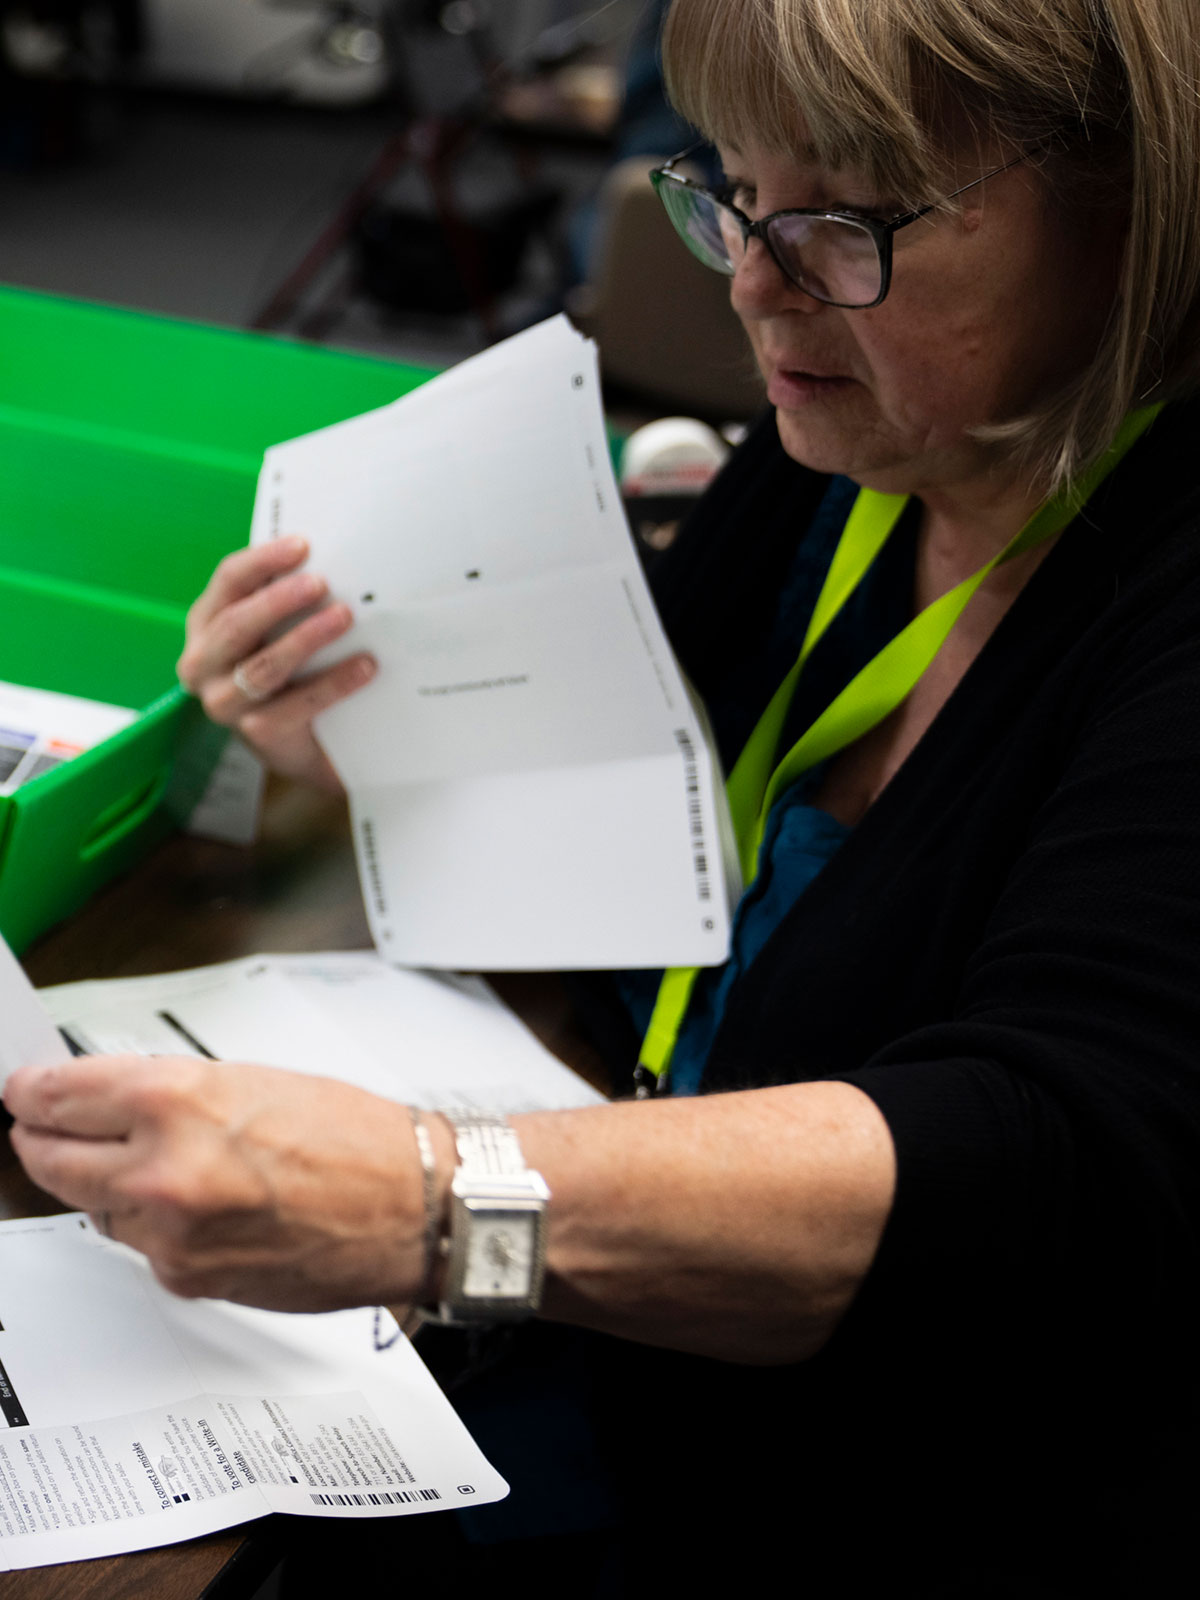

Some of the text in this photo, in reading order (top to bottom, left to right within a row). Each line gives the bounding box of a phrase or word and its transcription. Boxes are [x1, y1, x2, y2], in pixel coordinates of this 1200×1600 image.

[0, 1387, 12, 1398] End
[196, 1418, 216, 1447] Write-in
[132, 1441, 151, 1469] mistake
[214, 1452, 226, 1463] for
[222, 1463, 235, 1480] vote
[232, 1450, 256, 1484] candidate
[148, 1474, 166, 1499] correct
[231, 1480, 241, 1491] To
[161, 1500, 171, 1510] To
